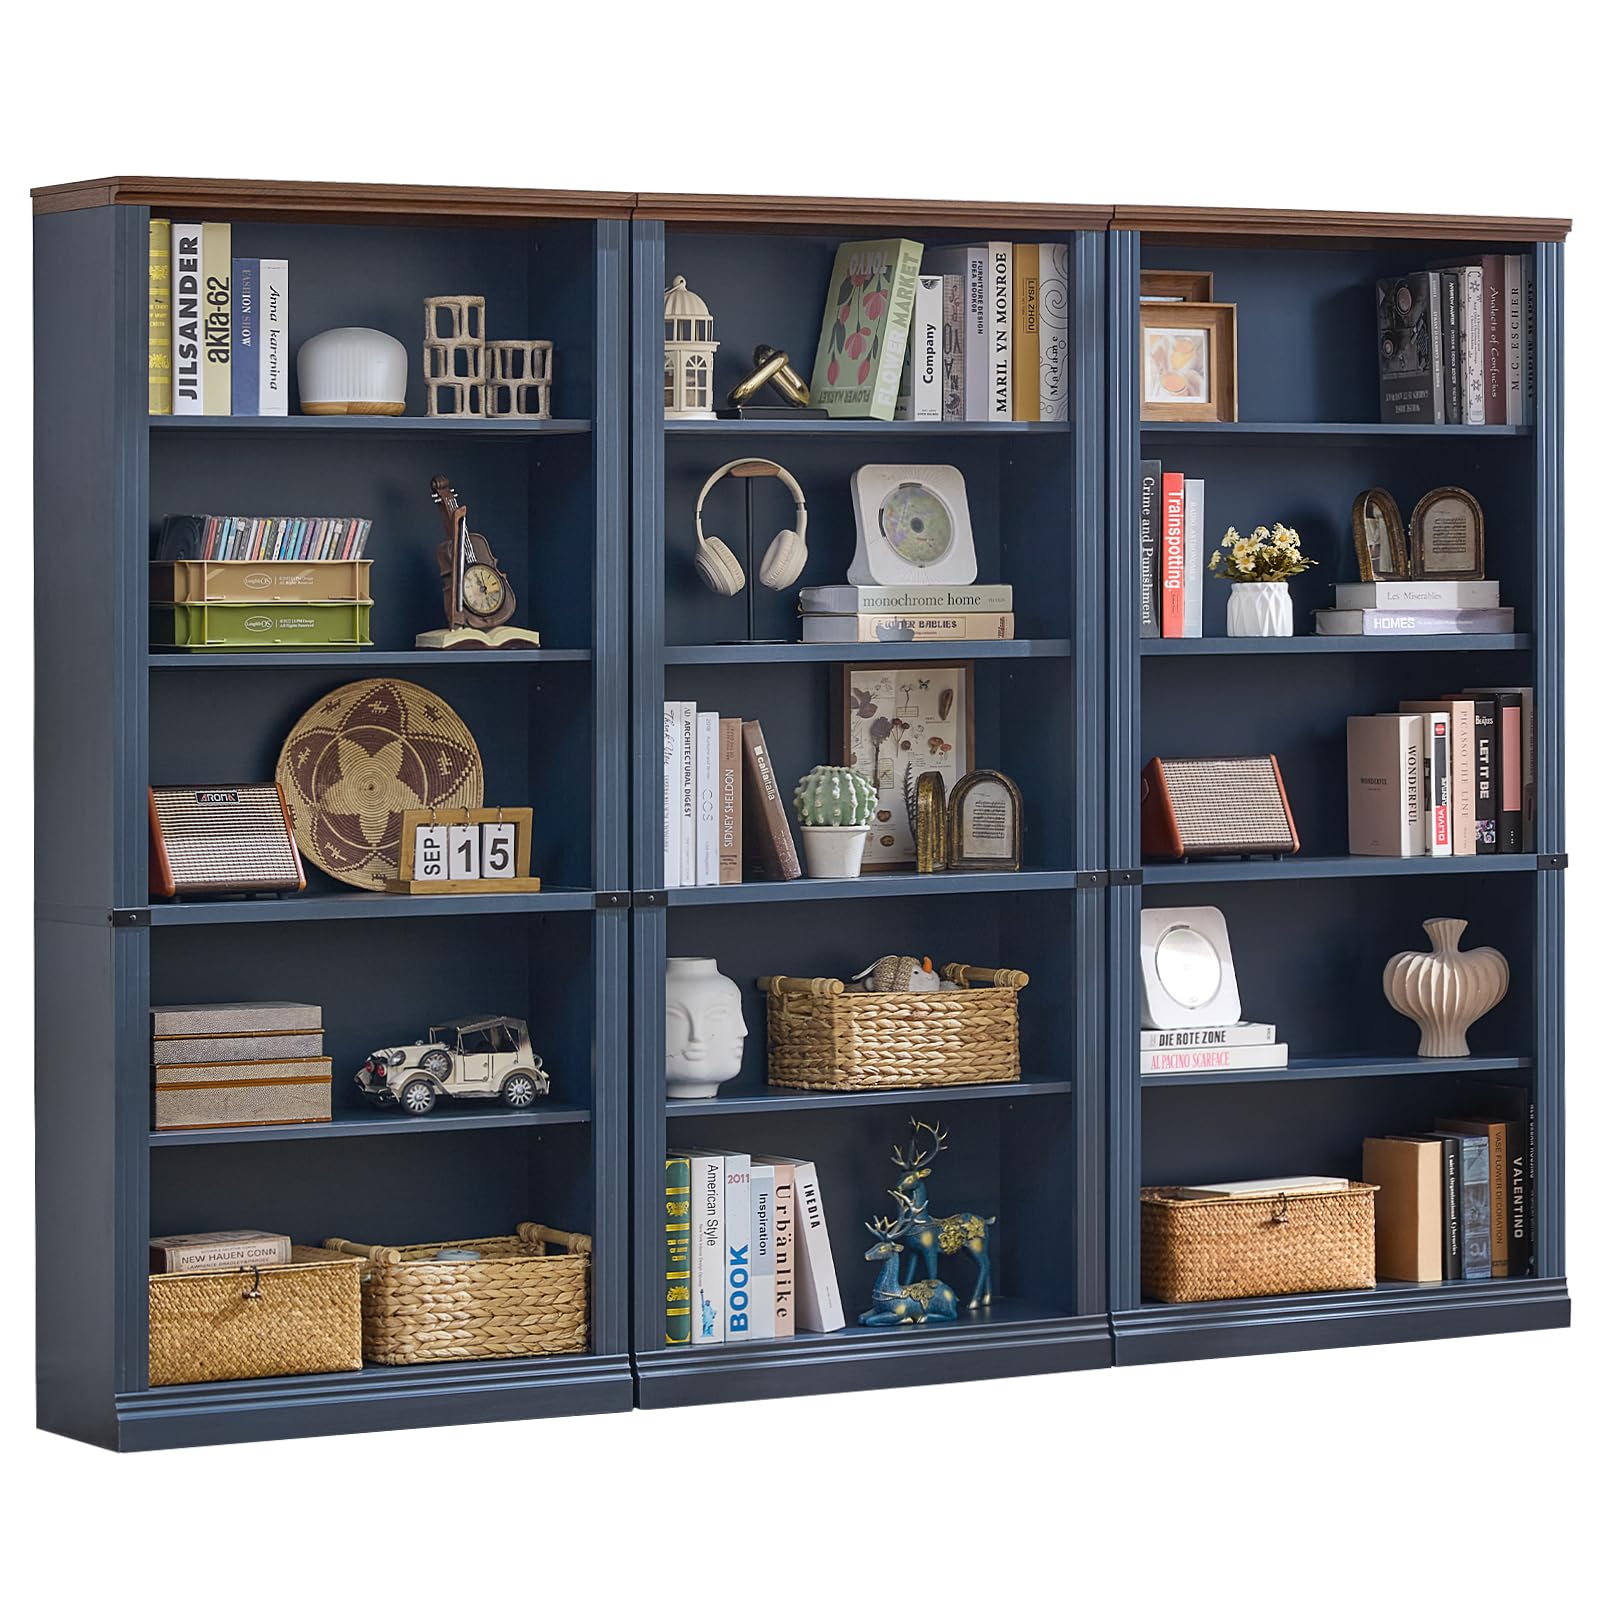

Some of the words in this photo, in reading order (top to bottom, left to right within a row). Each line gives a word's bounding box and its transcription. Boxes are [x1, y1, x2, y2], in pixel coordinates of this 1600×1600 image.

[242, 269, 252, 313] FASHION
[269, 285, 281, 322] Anna
[995, 252, 1007, 324] MONROE
[1027, 280, 1035, 304] LISA
[179, 236, 198, 400] JILSANDER
[1027, 304, 1036, 332] ZHOU
[1490, 286, 1499, 332] Analects
[240, 314, 252, 347] SHOW
[878, 330, 905, 406] FLOWER
[892, 253, 919, 328] MARKET
[996, 330, 1007, 353] YN
[1489, 333, 1500, 345] of
[923, 323, 937, 384] Company
[996, 359, 1007, 413] MARIL
[1490, 346, 1501, 398] Confucius
[1142, 477, 1155, 516] Crime
[1142, 518, 1154, 544] and
[863, 593, 944, 607] monochrome
[947, 592, 981, 605] home
[1142, 546, 1154, 625] Punishment
[1387, 591, 1400, 601] Les
[1403, 590, 1442, 601] Miserables
[1373, 617, 1416, 629] HOMES
[1460, 710, 1468, 757] PICASSO
[1479, 739, 1488, 763] LET
[684, 720, 692, 787] ARCHITECTURAL
[1408, 745, 1417, 826] WONDERFUL
[1460, 761, 1468, 784] THE
[1479, 766, 1489, 778] IT
[684, 788, 692, 818] DIGEST
[724, 768, 735, 814] SHELDON
[1480, 781, 1489, 799] BE
[723, 815, 734, 848] SIDNEY
[1438, 808, 1446, 842] OLIVIA
[423, 838, 441, 876] SEP
[1159, 1033, 1174, 1047] DIE
[1176, 1031, 1200, 1046] ROTE
[1202, 1030, 1226, 1044] ZONE
[1151, 1055, 1161, 1070] AL
[1161, 1053, 1190, 1069] PACINO
[1192, 1051, 1230, 1068] SCARFACE
[707, 1164, 719, 1216] American
[727, 1173, 750, 1184] 2011
[1513, 1156, 1523, 1238] VALENTINO
[704, 1219, 718, 1247] Style
[757, 1192, 768, 1256] Inspiration
[181, 1254, 206, 1264] NEW
[246, 1247, 277, 1258] CONN
[776, 1183, 791, 1318] Urbänlike
[730, 1243, 749, 1332] BOOK
